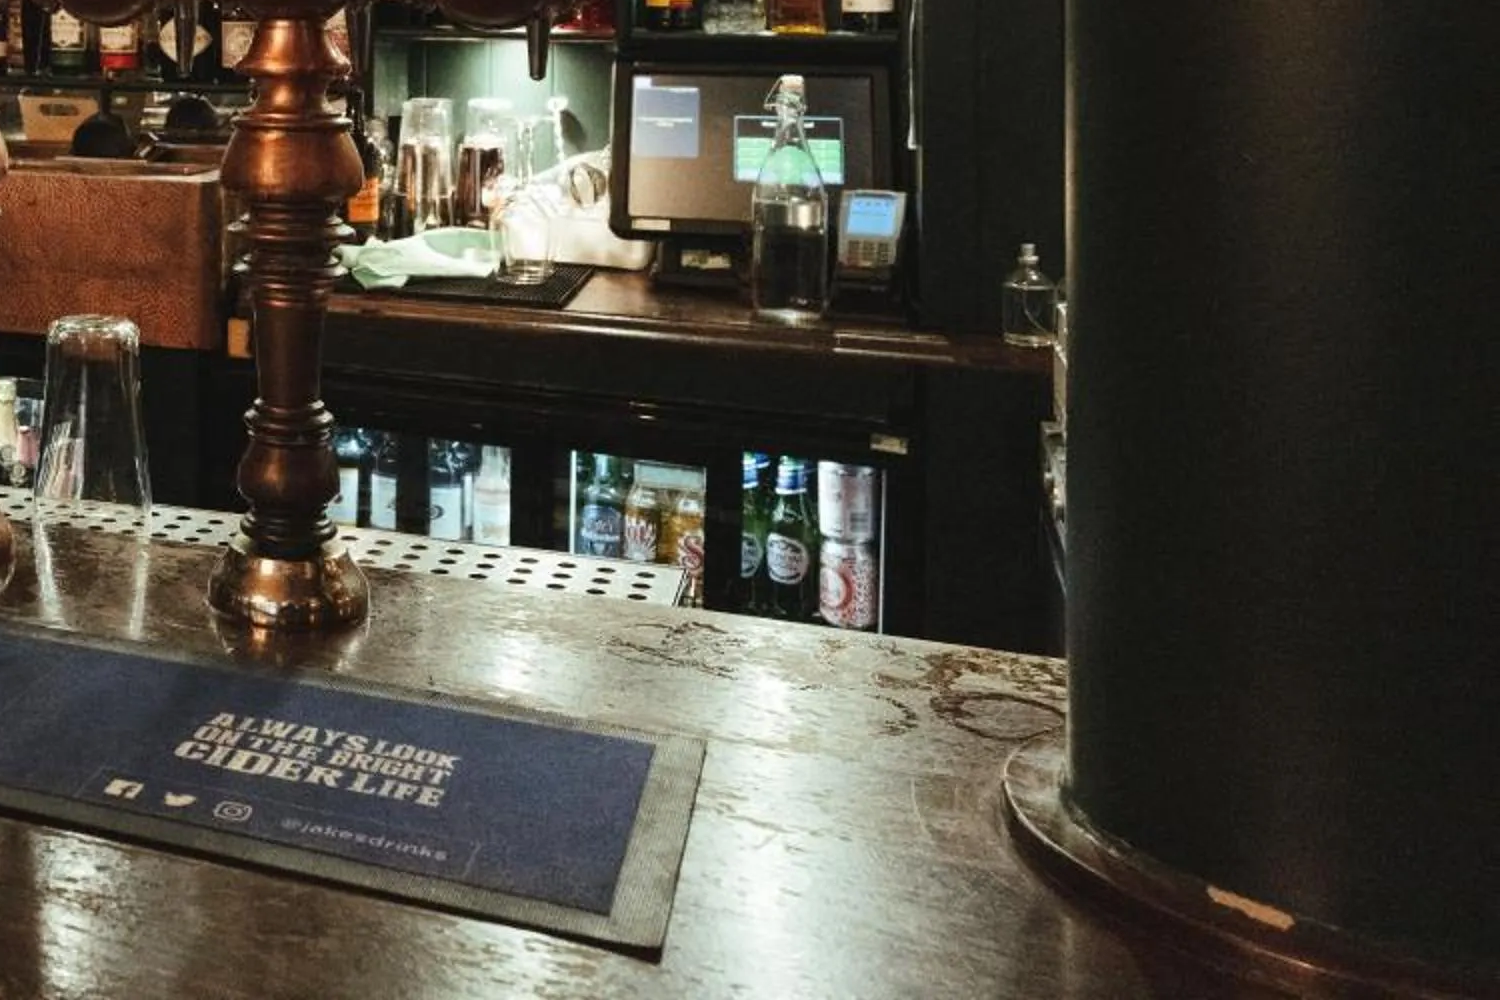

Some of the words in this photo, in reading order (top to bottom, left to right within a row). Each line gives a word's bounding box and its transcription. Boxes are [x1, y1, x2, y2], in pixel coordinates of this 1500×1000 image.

[193, 725, 243, 745] ON
[249, 735, 324, 763] THE
[327, 749, 454, 786] BRIGHT
[208, 711, 369, 752] ALWAYS
[369, 738, 464, 771] LOOK
[173, 740, 346, 789] CIDER
[347, 773, 447, 808] LIFE
[280, 817, 448, 862] @jakesdrinks
